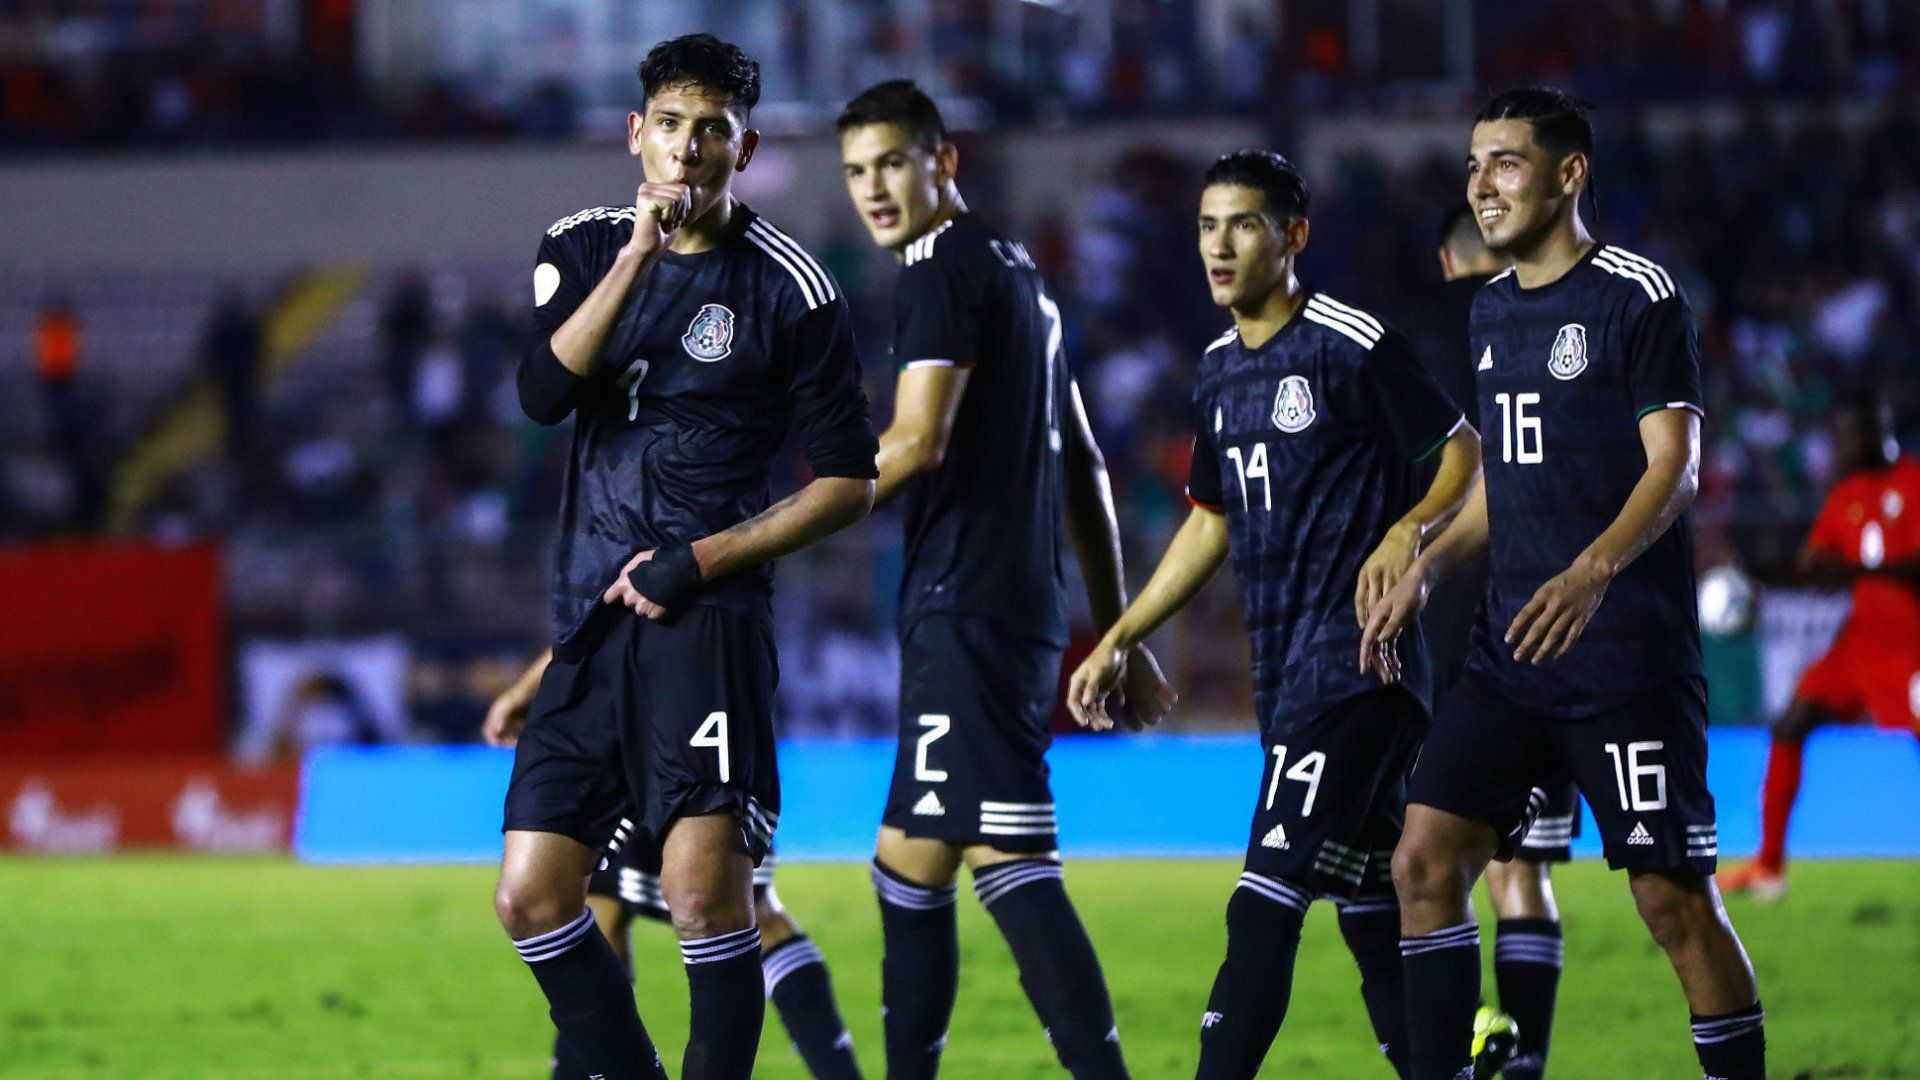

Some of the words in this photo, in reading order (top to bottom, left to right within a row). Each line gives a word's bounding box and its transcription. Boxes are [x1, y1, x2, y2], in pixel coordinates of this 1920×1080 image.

[1495, 392, 1544, 464] 16
[1226, 442, 1272, 513] 14
[689, 711, 730, 783] 4
[915, 714, 950, 782] 2
[1266, 744, 1326, 817] 14
[1604, 740, 1667, 812] 16
[1627, 836, 1655, 845] adidas
